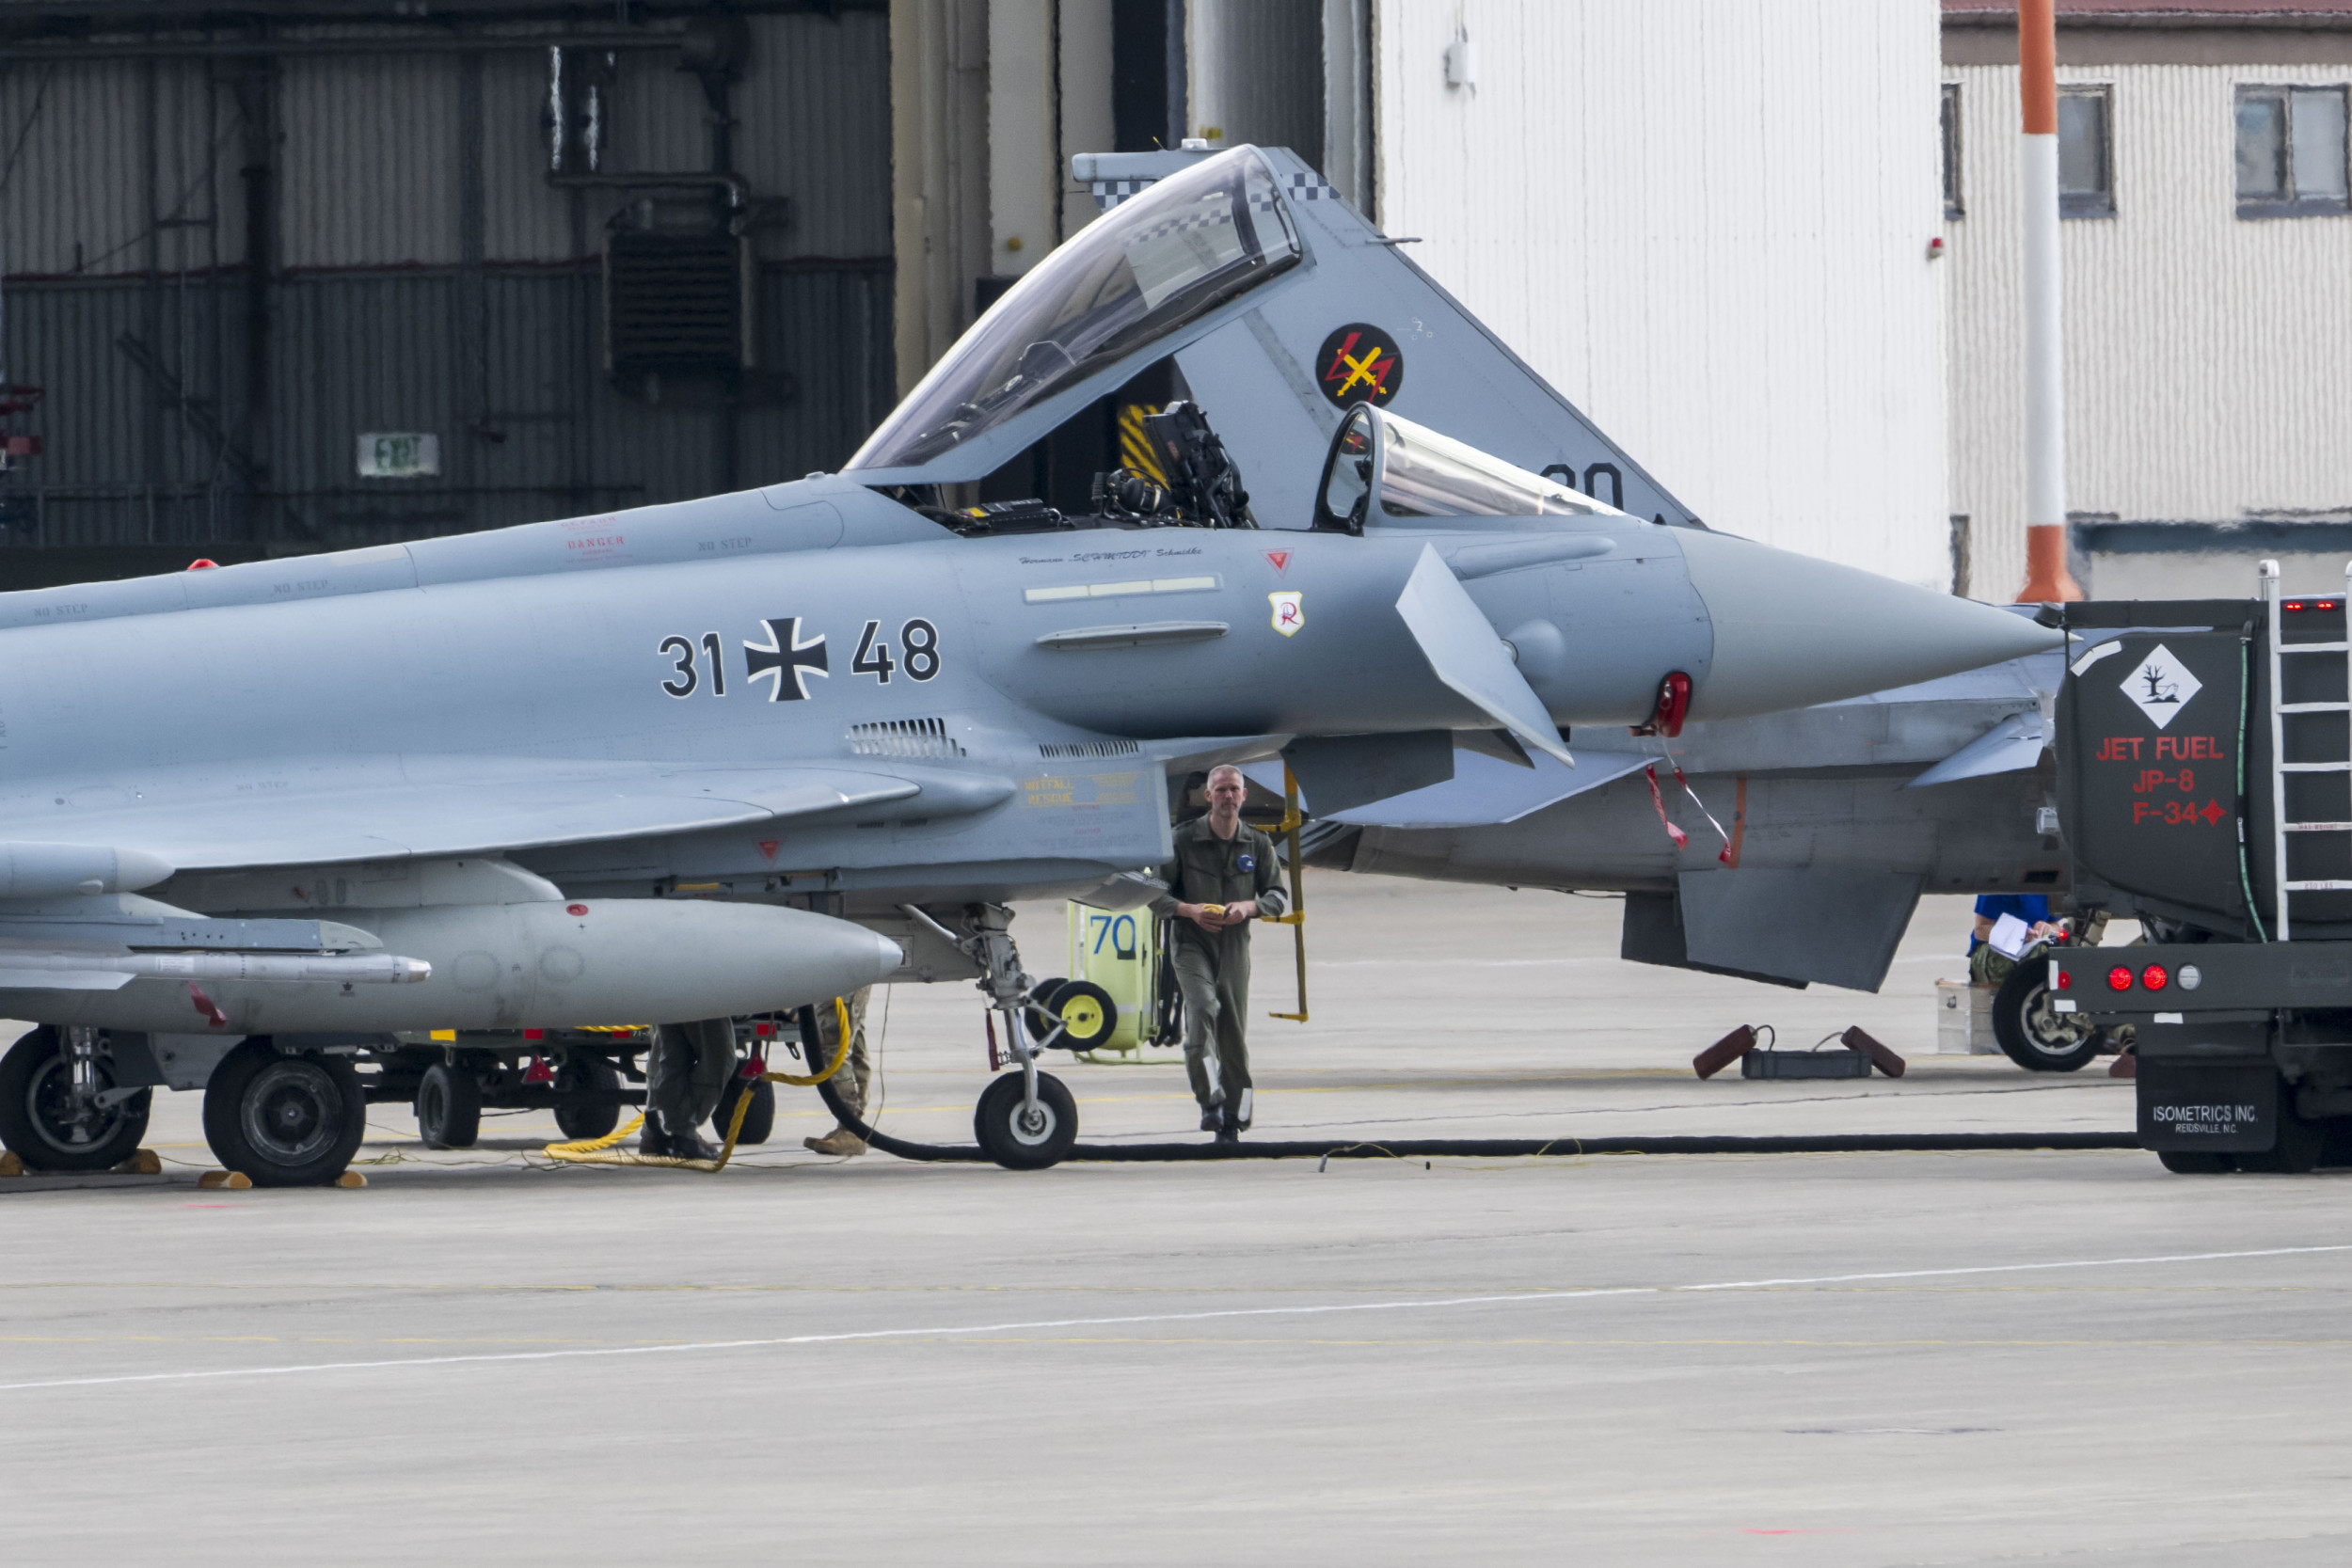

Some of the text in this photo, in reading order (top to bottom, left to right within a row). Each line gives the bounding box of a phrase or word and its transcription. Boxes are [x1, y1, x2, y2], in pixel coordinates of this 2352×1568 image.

[566, 535, 625, 550] DANGER
[697, 536, 752, 552] NO STEP
[273, 578, 328, 594] NO STEP
[34, 602, 88, 618] NO STEP
[658, 617, 941, 699] 31 48
[2095, 736, 2224, 761] JET FUEL
[2132, 768, 2195, 793] JP-8
[2133, 800, 2199, 825] F-34
[1089, 914, 1136, 955] 70
[2153, 1104, 2259, 1123] ISOMETRICS INC.
[2175, 1123, 2221, 1133] REIDSVILLE,
